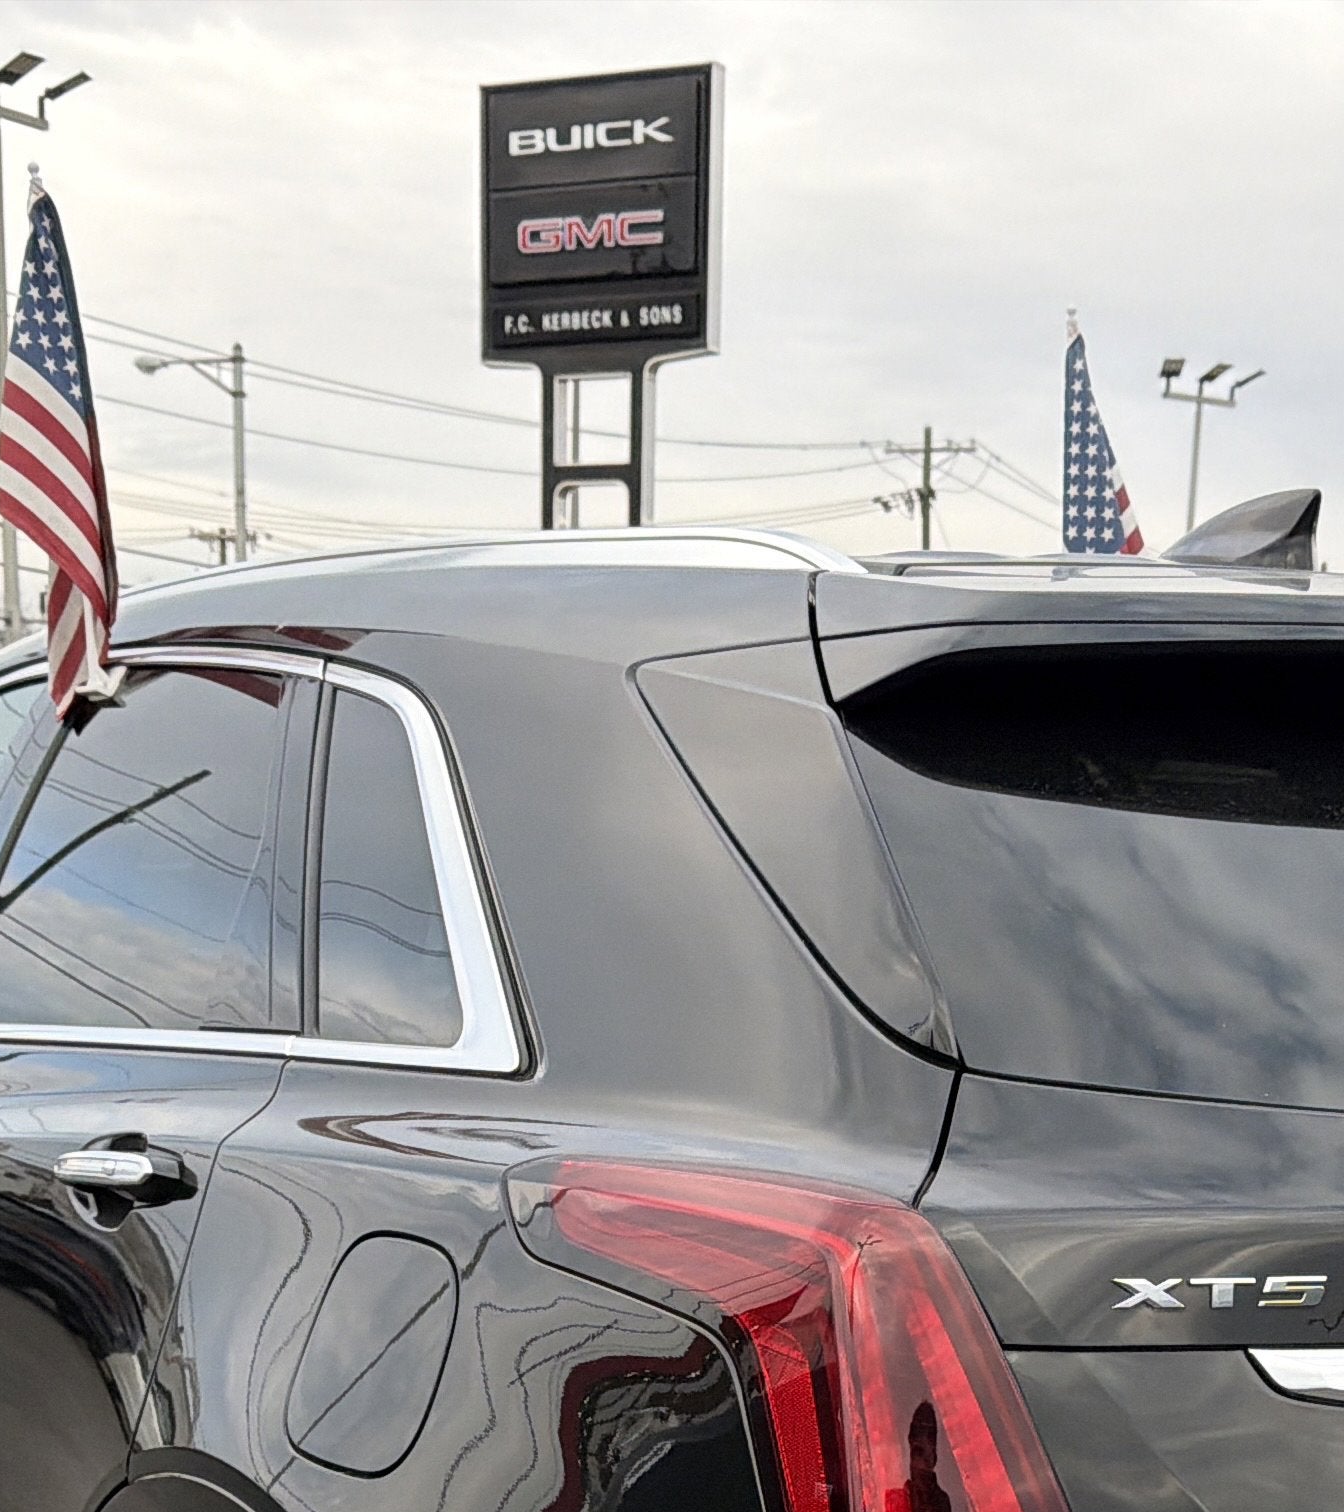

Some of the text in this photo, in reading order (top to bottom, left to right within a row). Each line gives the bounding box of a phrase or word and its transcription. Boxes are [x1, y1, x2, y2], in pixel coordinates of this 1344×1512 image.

[508, 116, 674, 156] BUICK
[517, 209, 664, 254] GMC
[504, 303, 683, 335] F.C. KERBECK & SONS
[1111, 1275, 1328, 1309] XT5
